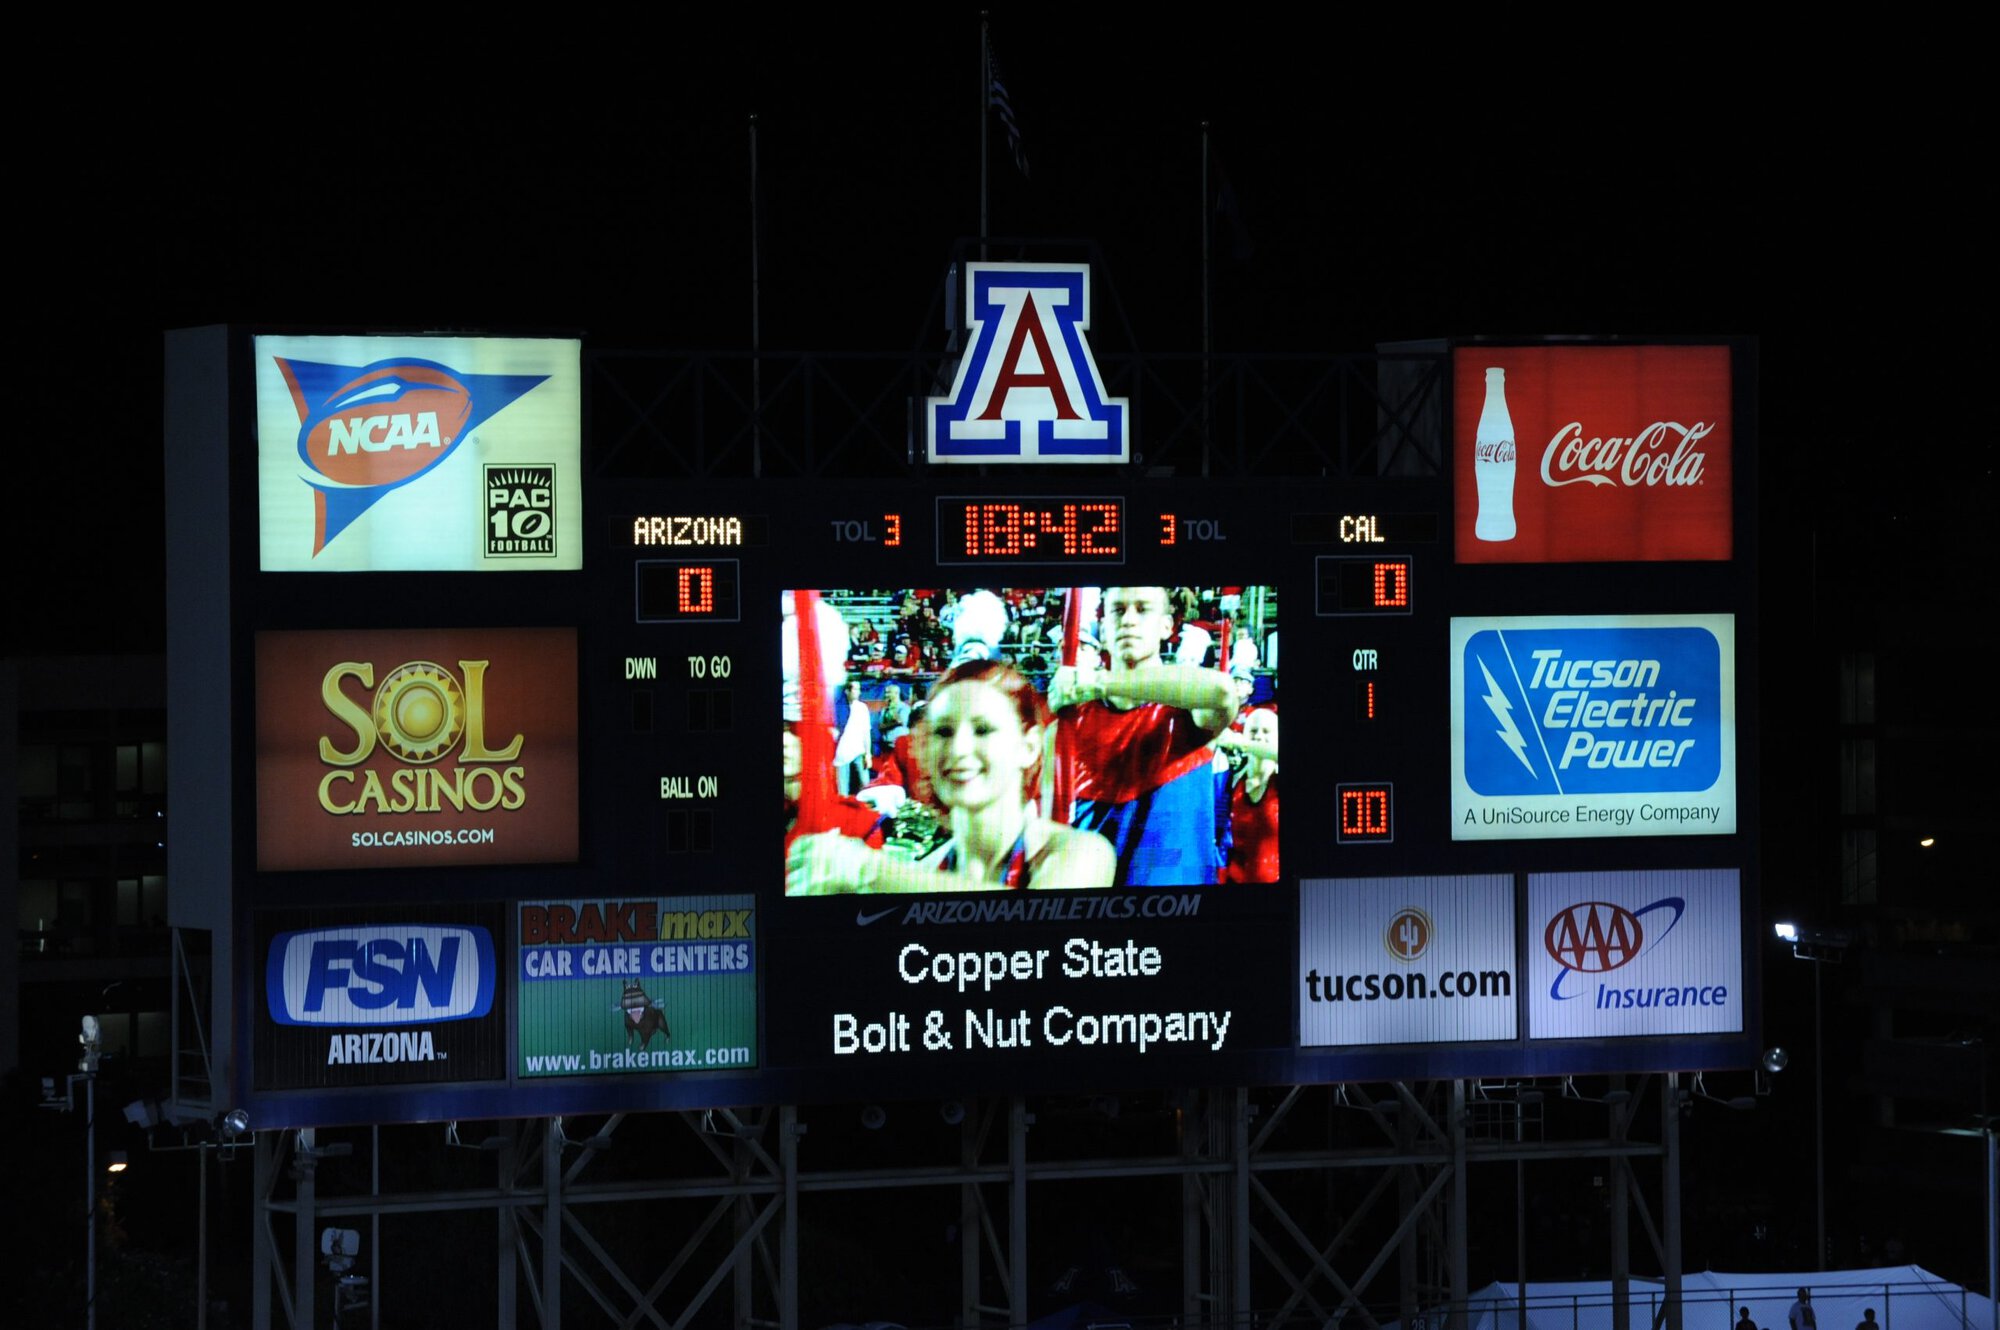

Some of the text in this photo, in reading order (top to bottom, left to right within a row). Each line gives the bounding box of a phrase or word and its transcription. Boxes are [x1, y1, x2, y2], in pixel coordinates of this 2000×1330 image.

[927, 261, 1130, 464] A
[328, 411, 440, 456] NCAA
[1540, 422, 1715, 488] Coca-Cola
[490, 489, 550, 508] PAC
[491, 510, 551, 538] 10
[634, 517, 742, 545] ARIZONA
[831, 514, 900, 546] TOL 3
[965, 504, 1119, 556] 18:42
[1160, 514, 1226, 545] 3 TOL
[1339, 515, 1385, 543] CAL
[491, 540, 550, 552] FOOTBALL
[679, 567, 713, 613] 0
[1374, 563, 1407, 607] 0
[625, 657, 657, 679] DWN
[688, 656, 731, 678] TO GO
[1353, 649, 1378, 671] QTR
[1530, 649, 1661, 689] Tucson
[318, 659, 524, 766] SOL
[1368, 682, 1375, 719] 1
[1543, 690, 1696, 728] Electric
[1558, 731, 1695, 770] Power
[318, 766, 526, 815] CASINOS
[661, 776, 718, 799] BALL ON
[1342, 790, 1387, 834] 00
[1463, 803, 1721, 826] A UniSource Energy Company
[351, 828, 494, 847] SOLCASINOS.COM
[521, 901, 754, 945] BRAKE max
[902, 894, 1201, 926] ARIZONAATHLETICS.COM
[1551, 902, 1638, 972] AAA
[303, 936, 461, 1012] FSN
[525, 944, 750, 977] CAR CARE CENTERS
[899, 938, 1162, 992] Copper State
[1306, 968, 1511, 1002] tucson.com
[1596, 983, 1727, 1009] Insurance
[833, 1006, 1231, 1055] Bolt & Nut Company
[328, 1031, 435, 1066] ARIZONA
[526, 1047, 750, 1073] www.brakemax.com
